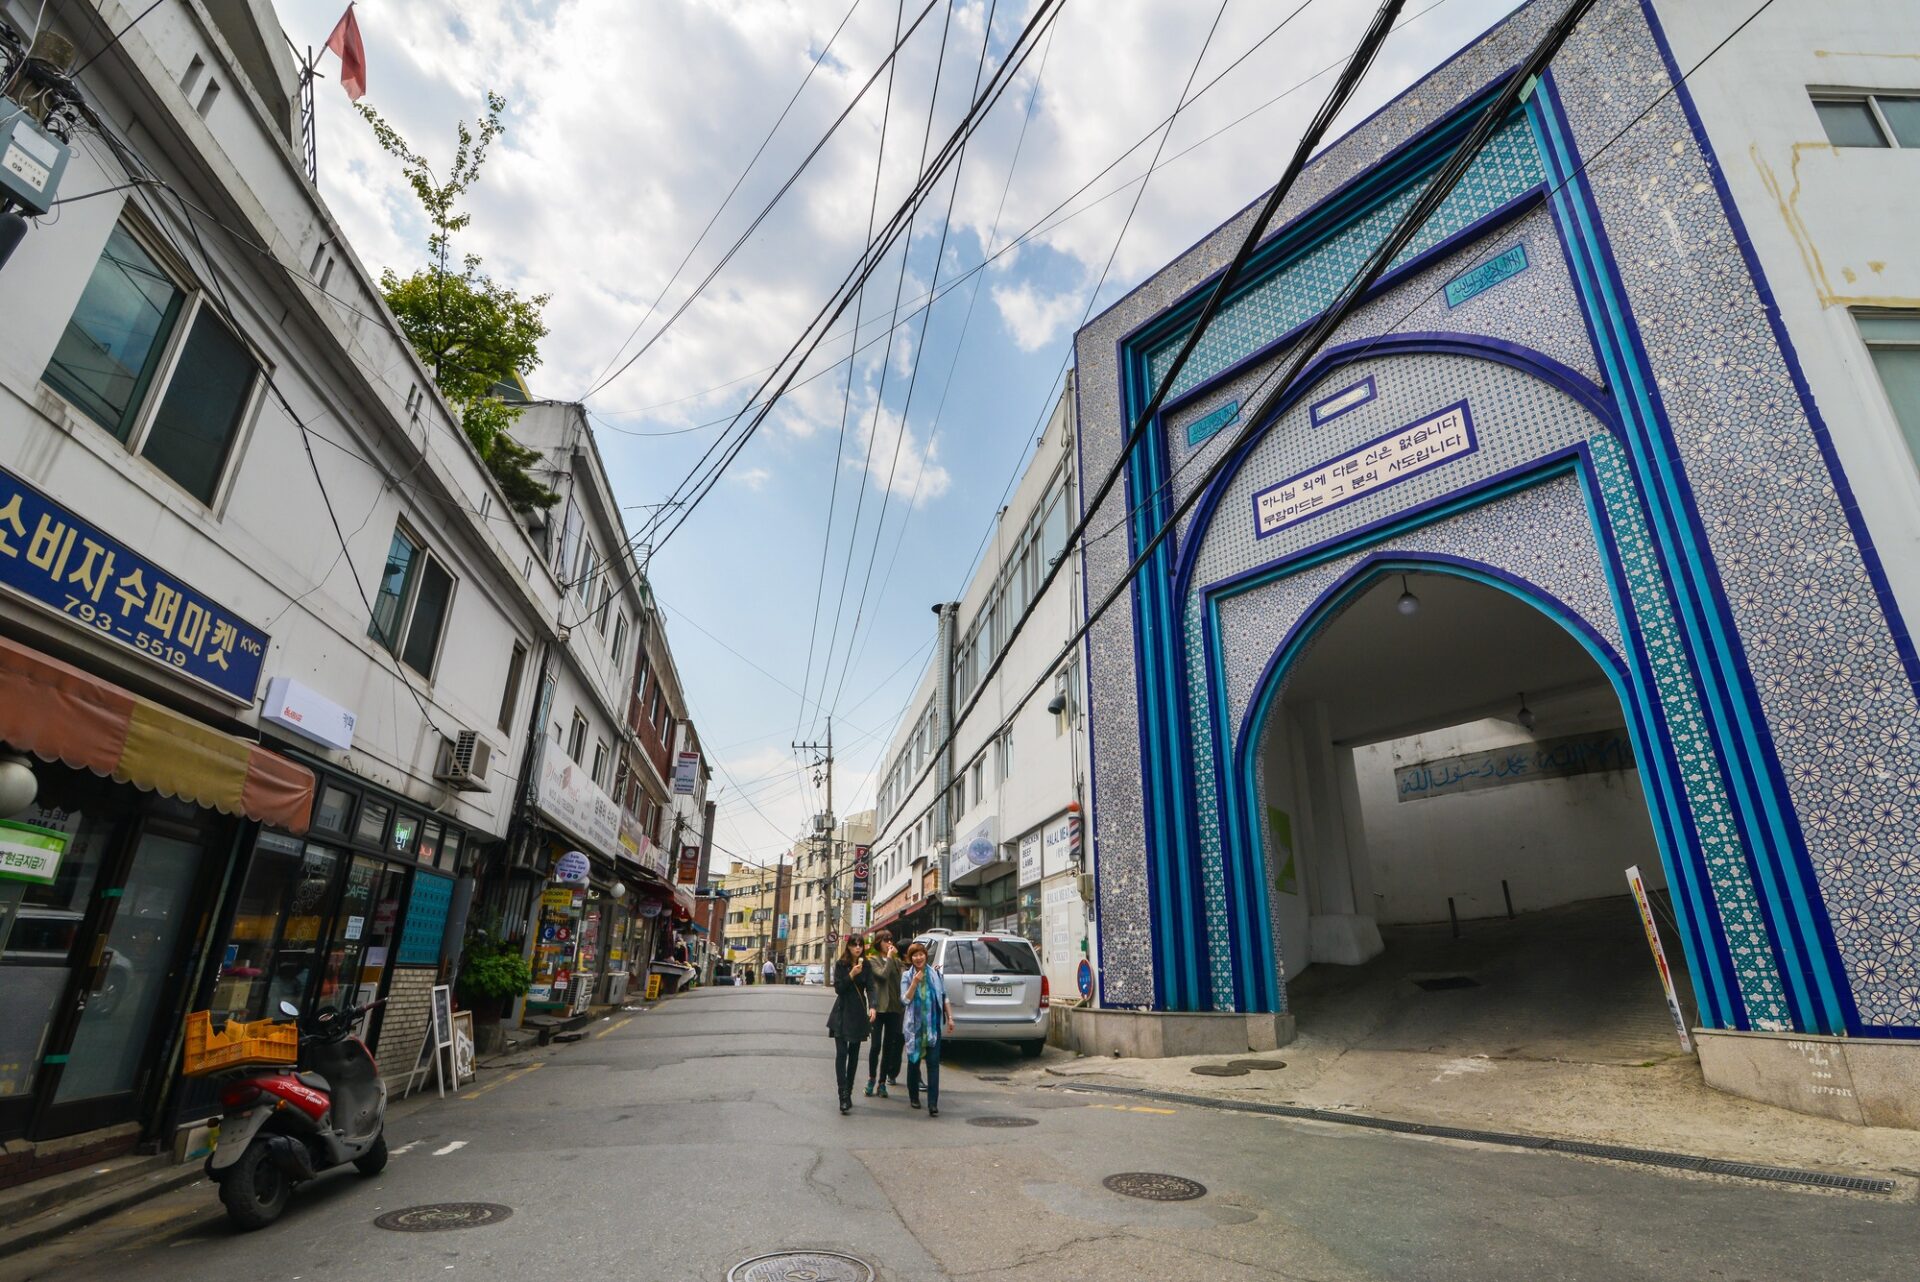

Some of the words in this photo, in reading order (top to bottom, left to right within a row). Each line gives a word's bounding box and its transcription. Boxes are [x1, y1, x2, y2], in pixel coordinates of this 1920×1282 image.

[1262, 487, 1296, 508] 하나님
[1302, 474, 1326, 492] 외에
[1333, 461, 1359, 478] 다른
[1399, 415, 1458, 451] 없습니다
[1263, 495, 1324, 526] 무함마드는
[1331, 485, 1345, 499] 그
[1352, 472, 1378, 490] 분의
[1388, 434, 1462, 473] 사도입니다
[0, 494, 237, 671] 소비자수퍼마켓
[240, 635, 262, 657] KVC
